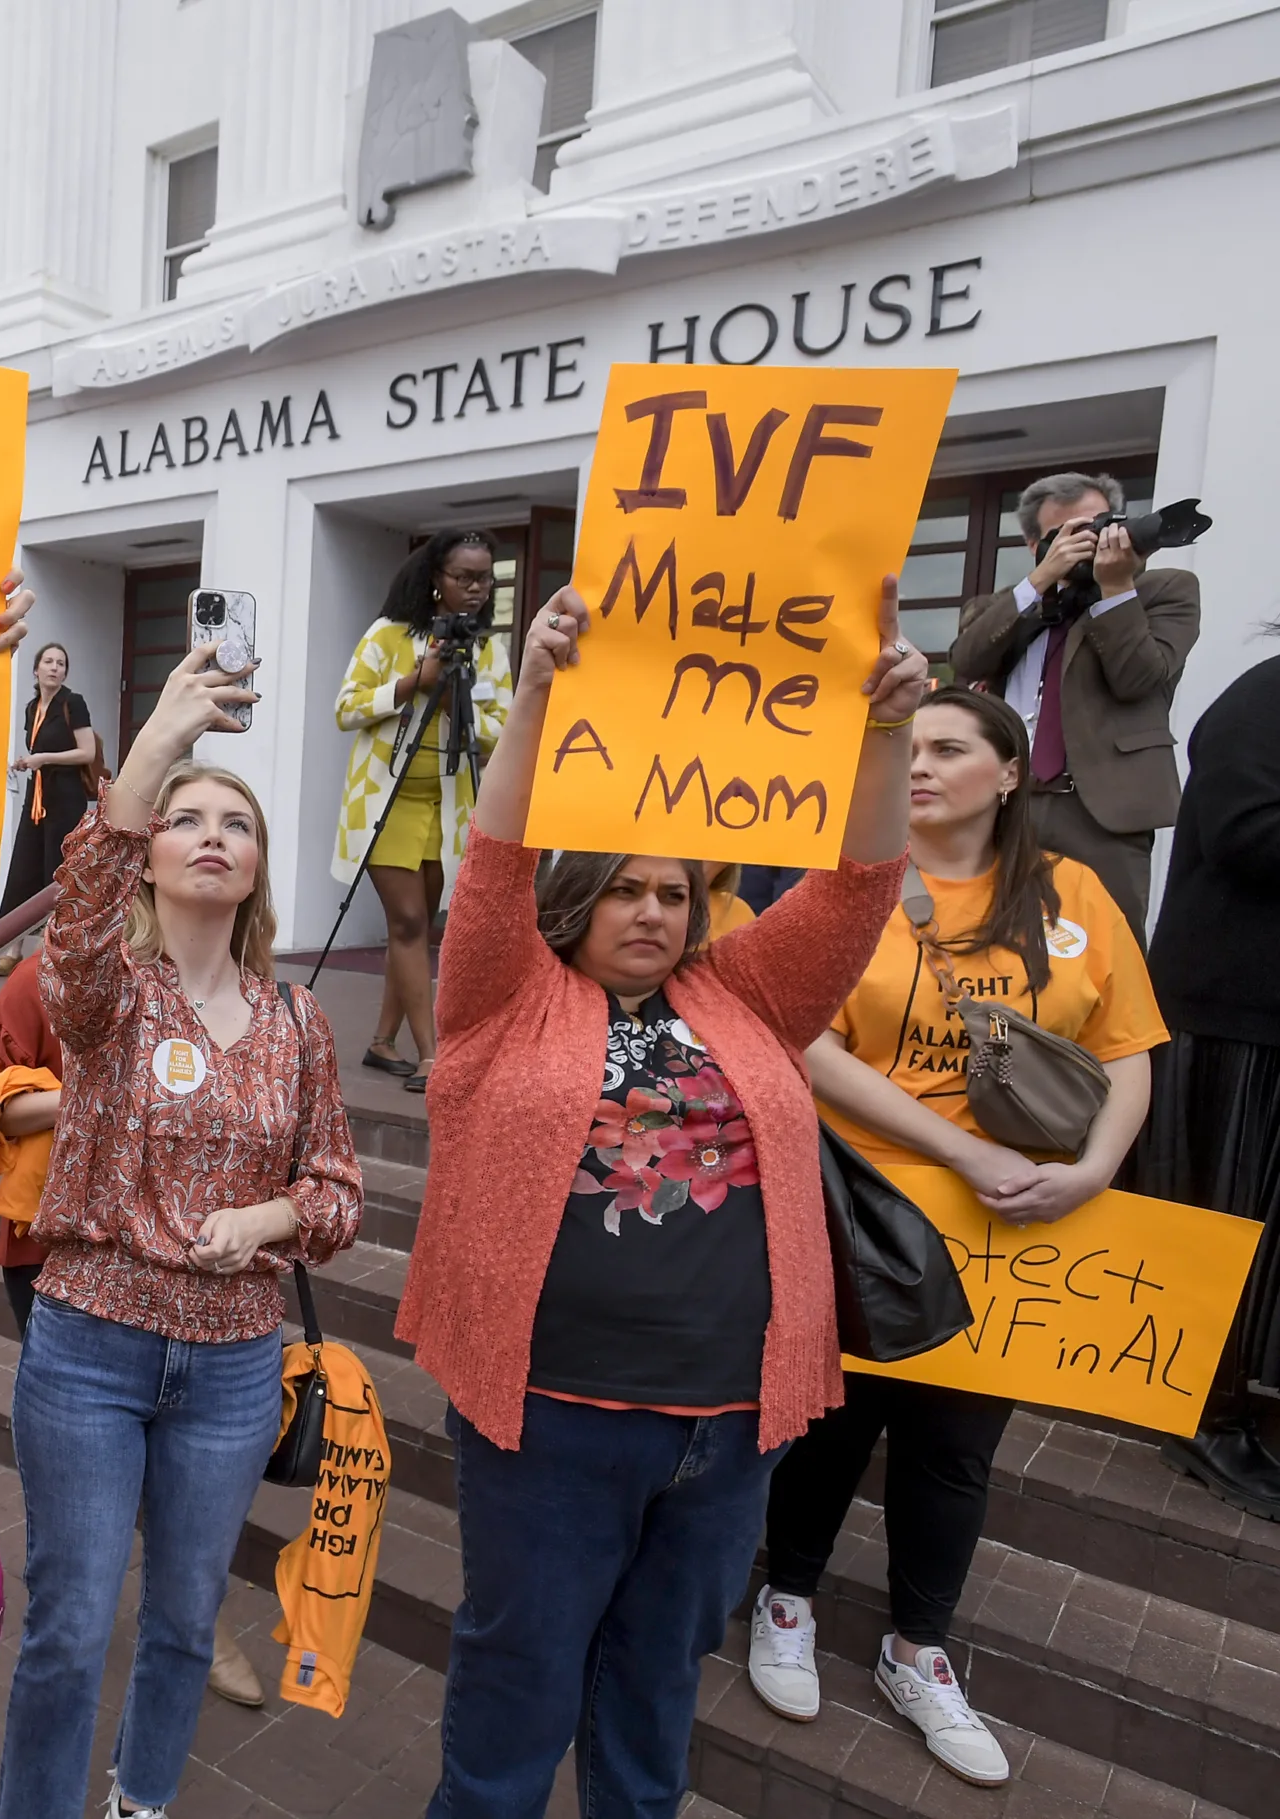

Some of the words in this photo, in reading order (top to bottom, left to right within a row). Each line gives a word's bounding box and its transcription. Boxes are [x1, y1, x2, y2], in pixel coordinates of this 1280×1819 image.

[277, 266, 368, 327] JURA
[384, 224, 555, 297] NOSTRA
[626, 130, 940, 247] DEFENDERE
[81, 388, 342, 484] ALABAMA
[385, 336, 586, 431] STATE
[646, 255, 984, 364] HOUSE
[612, 389, 885, 524] IVF
[552, 718, 614, 775] A
[908, 1025, 971, 1050] ALAB
[963, 1295, 1061, 1359] VF
